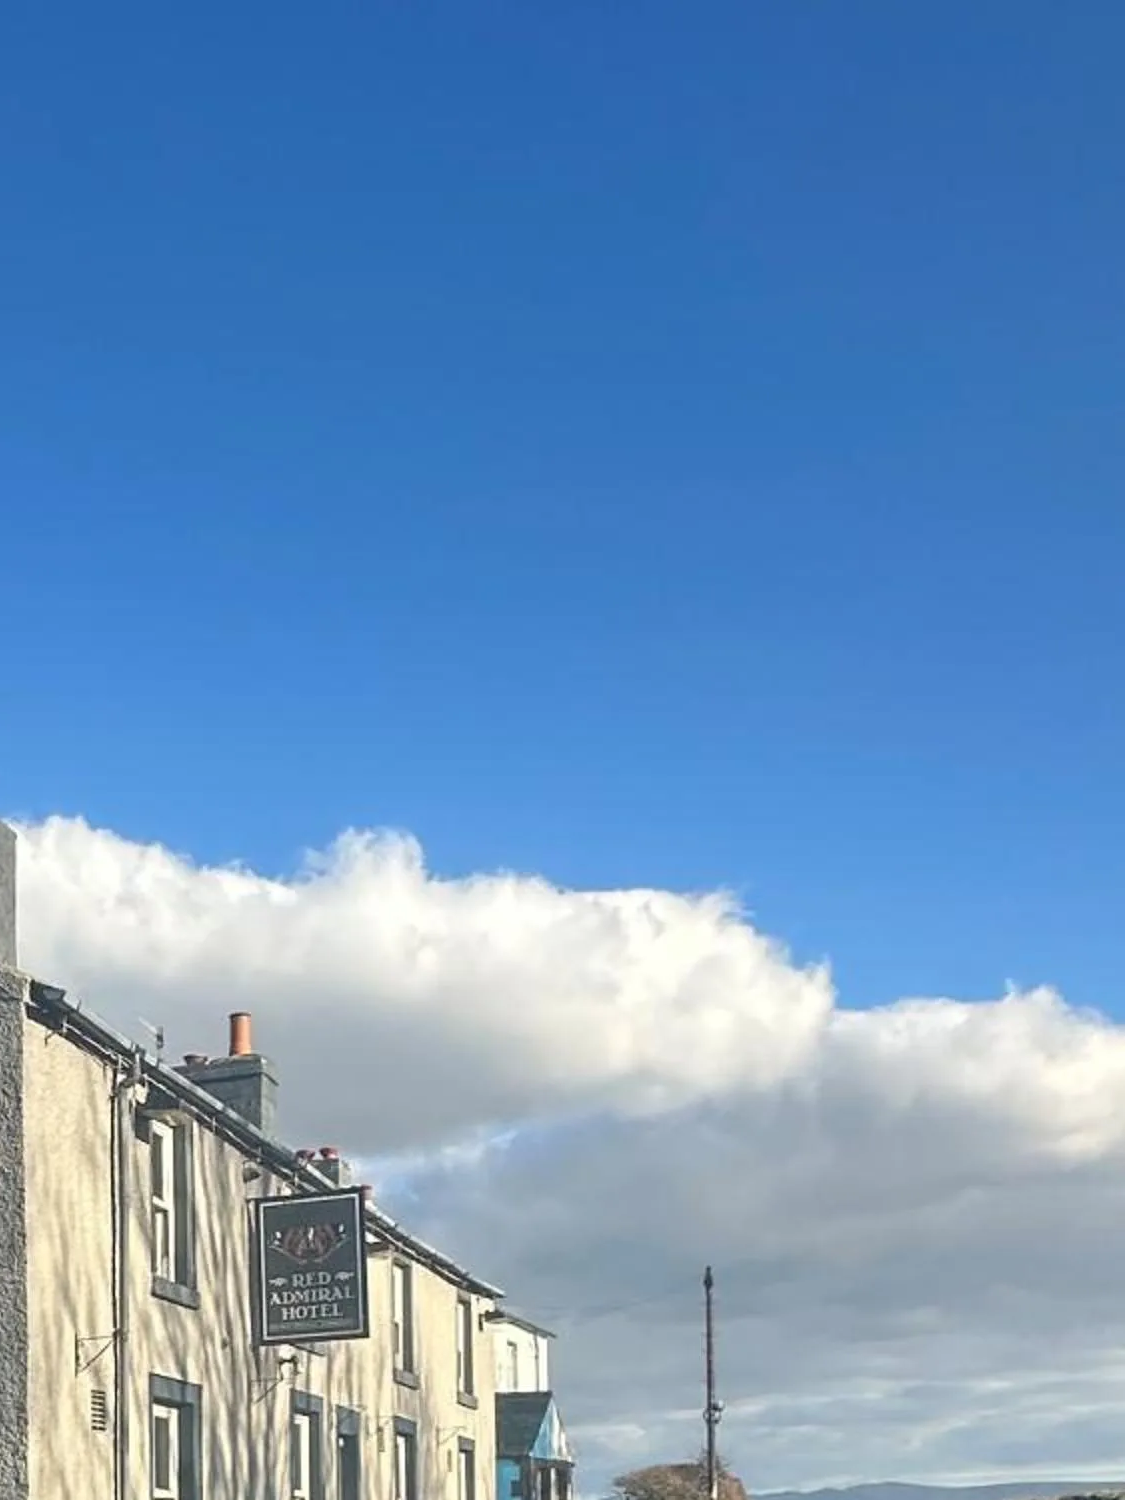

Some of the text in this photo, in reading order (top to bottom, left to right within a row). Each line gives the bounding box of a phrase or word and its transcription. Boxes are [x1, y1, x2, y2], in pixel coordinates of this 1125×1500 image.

[291, 1271, 332, 1288] RED
[269, 1284, 355, 1306] ADMIRAL
[281, 1302, 343, 1321] HOTEL
